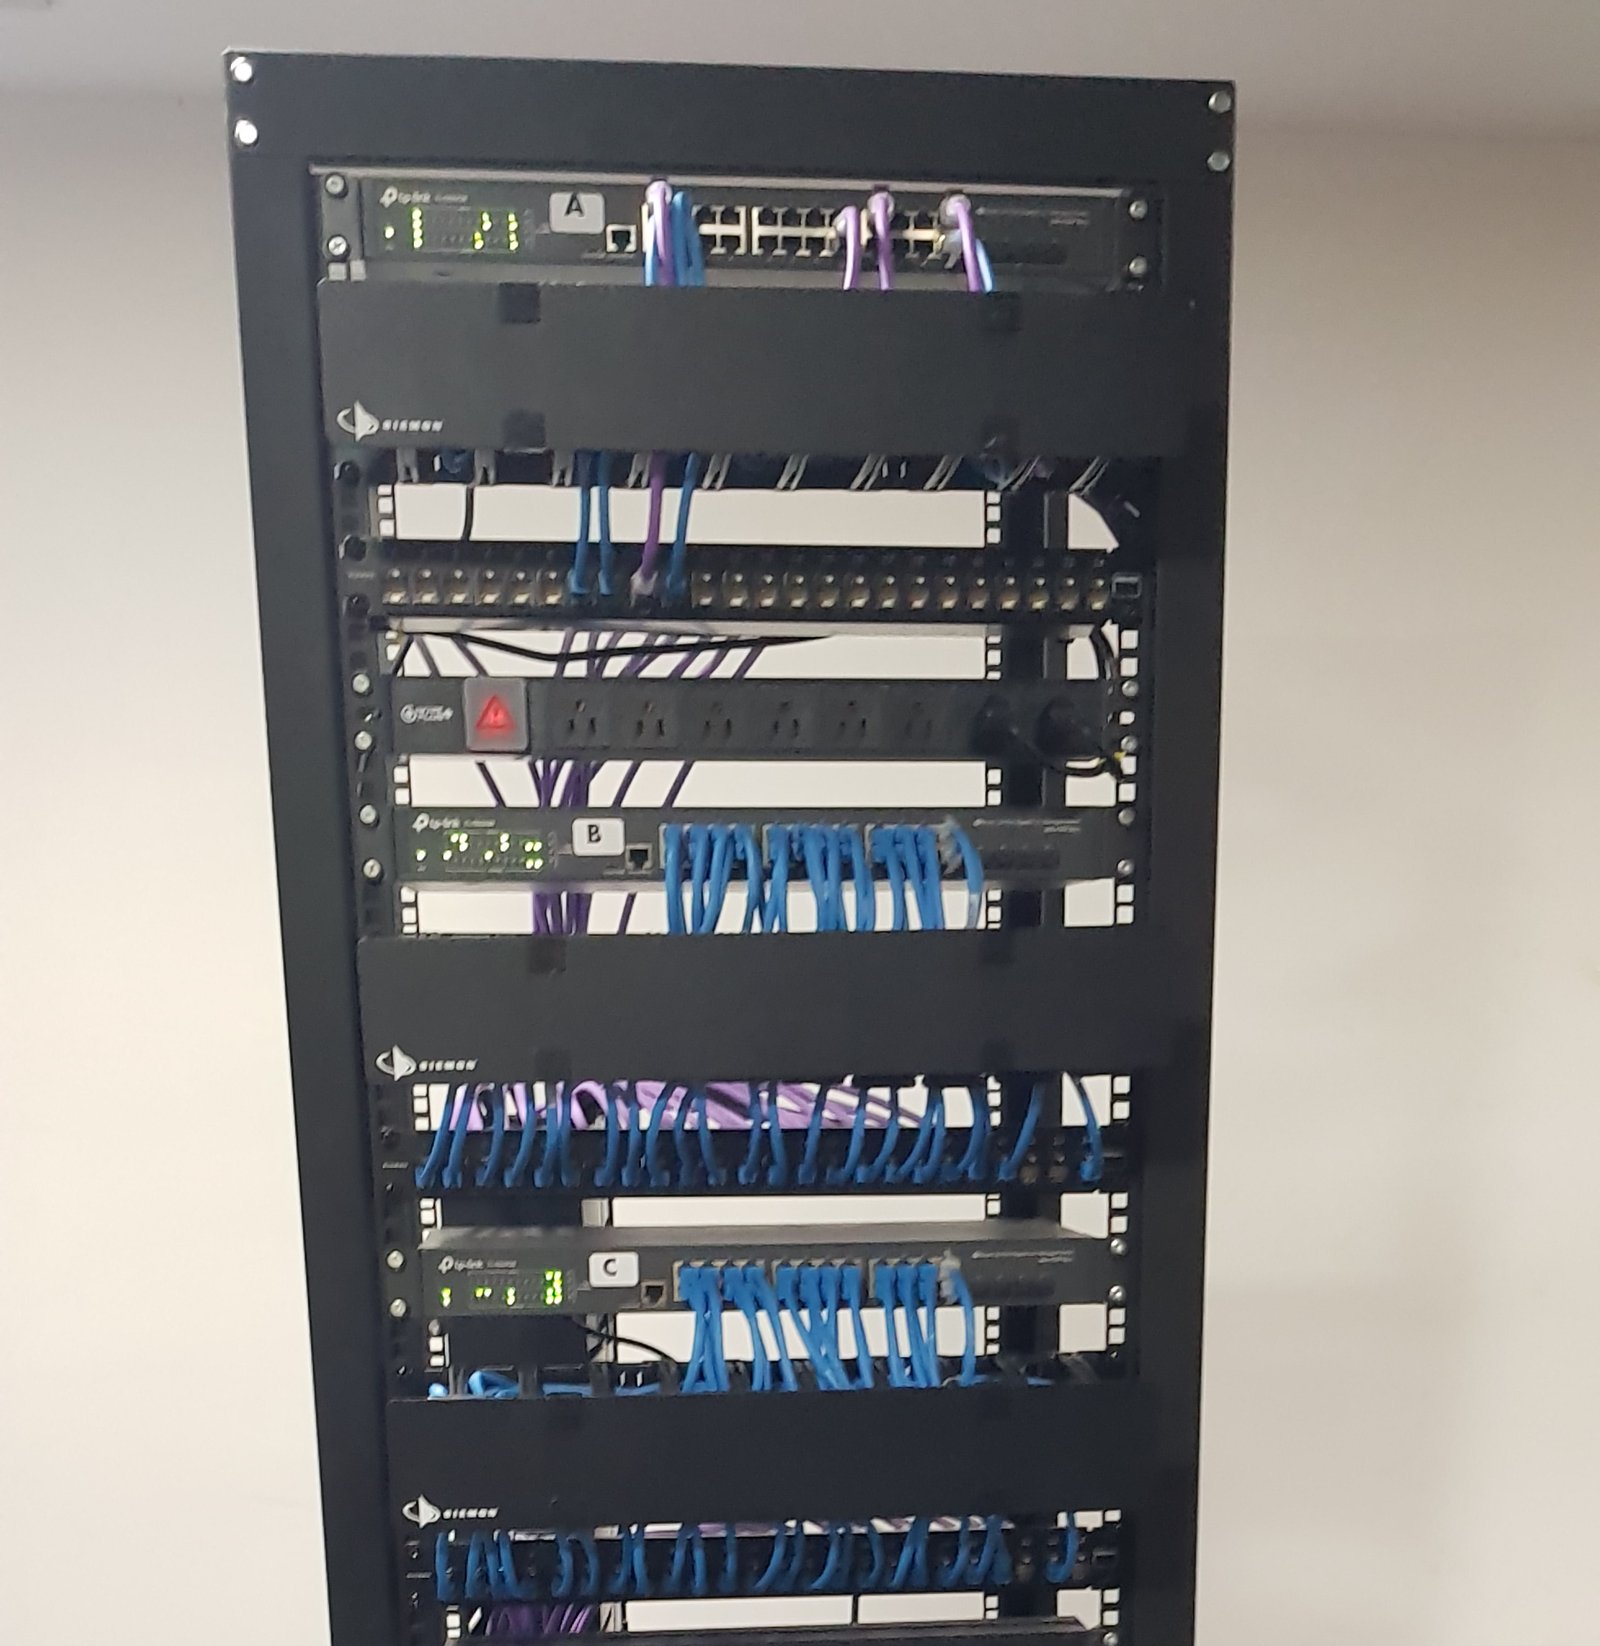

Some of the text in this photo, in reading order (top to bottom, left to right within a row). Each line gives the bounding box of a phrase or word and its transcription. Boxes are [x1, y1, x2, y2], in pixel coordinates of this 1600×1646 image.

[564, 192, 585, 217] A
[587, 824, 602, 844] B
[602, 1258, 618, 1277] C
